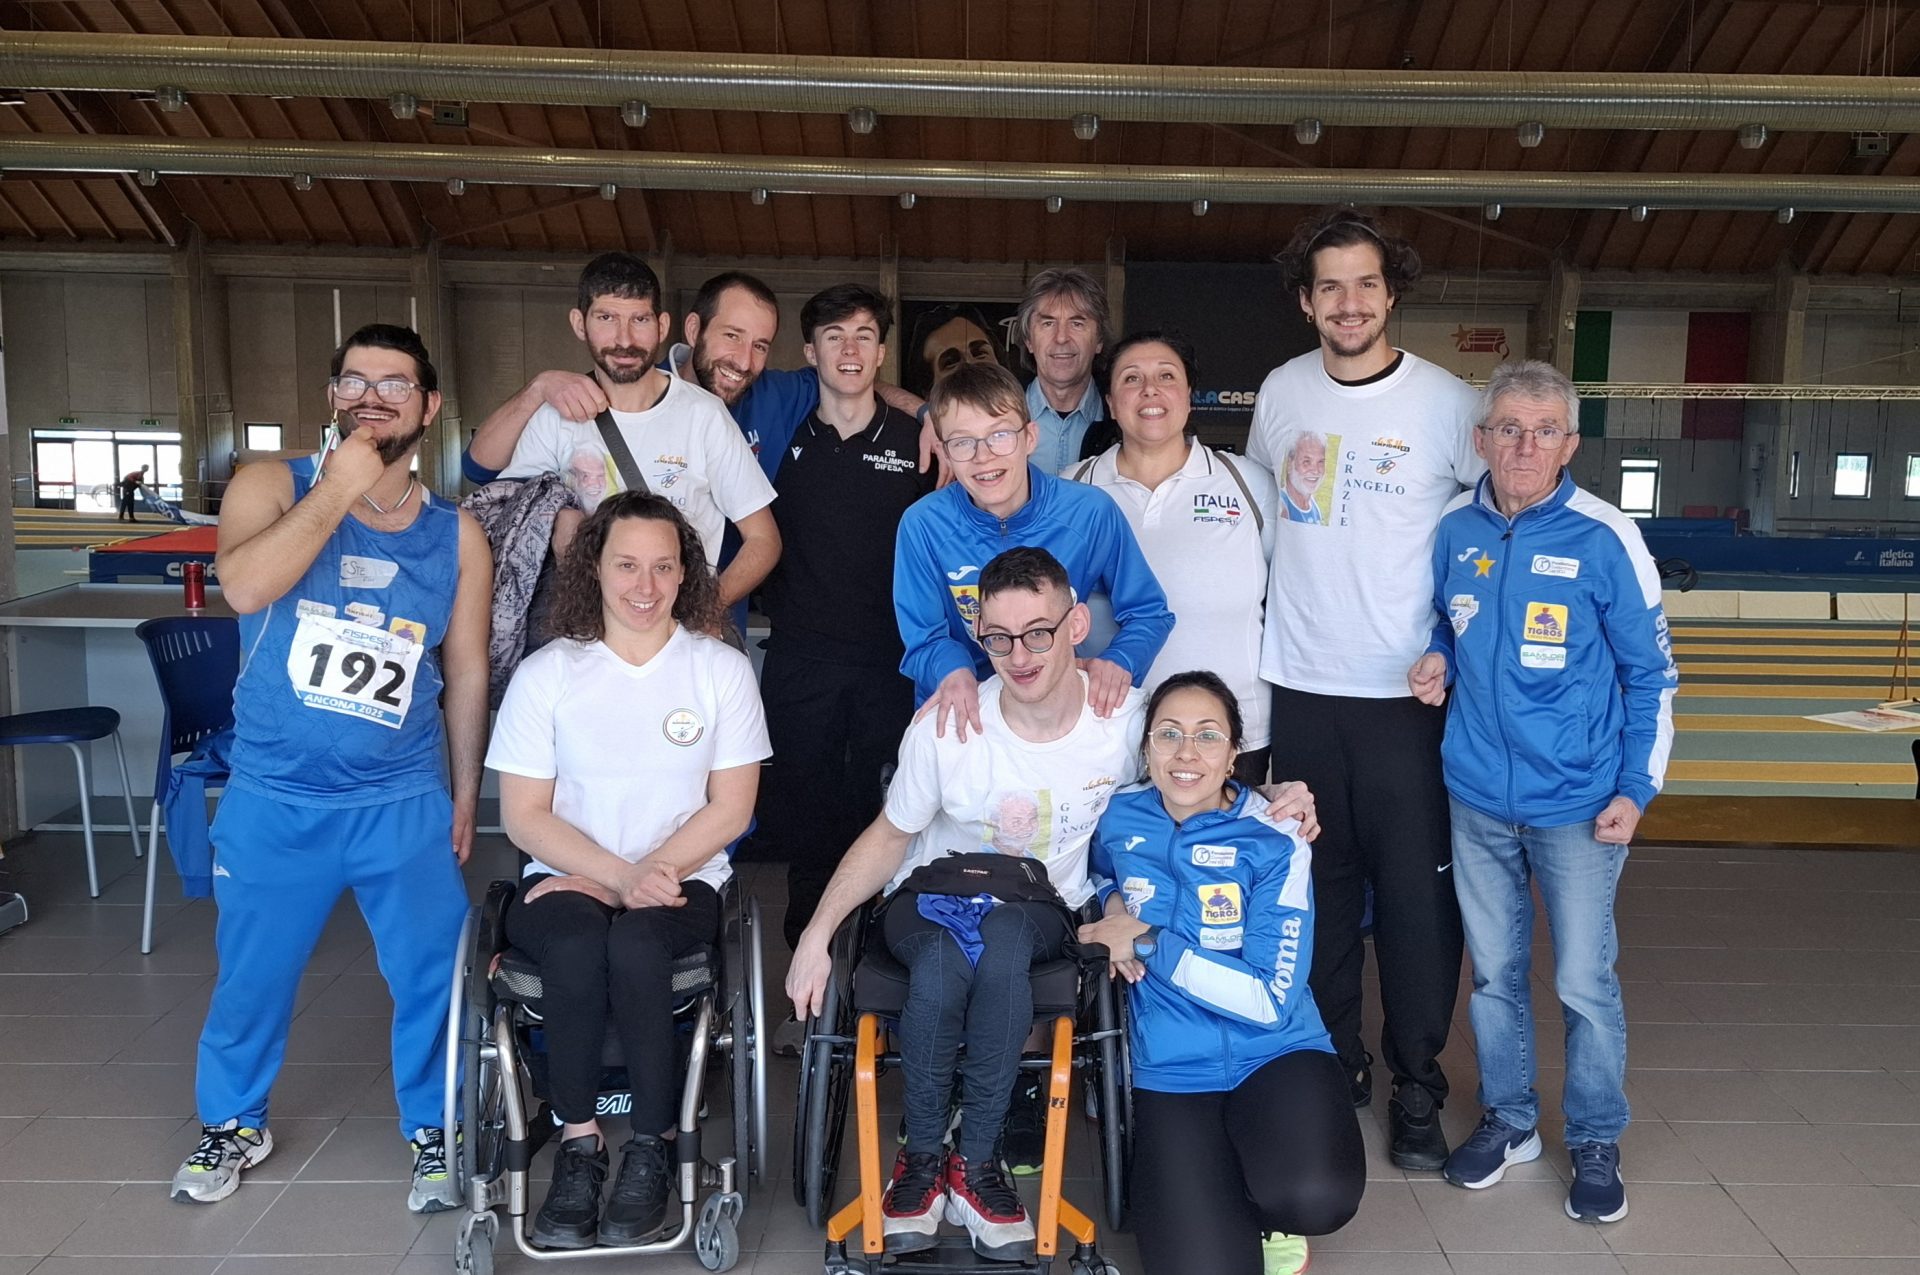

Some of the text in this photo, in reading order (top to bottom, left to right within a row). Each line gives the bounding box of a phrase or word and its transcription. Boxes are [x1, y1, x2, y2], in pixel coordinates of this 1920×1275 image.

[884, 449, 897, 458] GS
[863, 453, 915, 469] PARALIMPICO
[874, 462, 904, 473] DIFESA
[1194, 494, 1240, 510] ITALIA
[1880, 549, 1914, 559] atletica
[1879, 558, 1914, 567] italiana
[342, 628, 388, 646] FISPES
[1527, 627, 1563, 638] TIGROS
[309, 643, 406, 708] 192
[304, 694, 385, 719] ANCONA 2025
[1205, 909, 1238, 919] TIGROS
